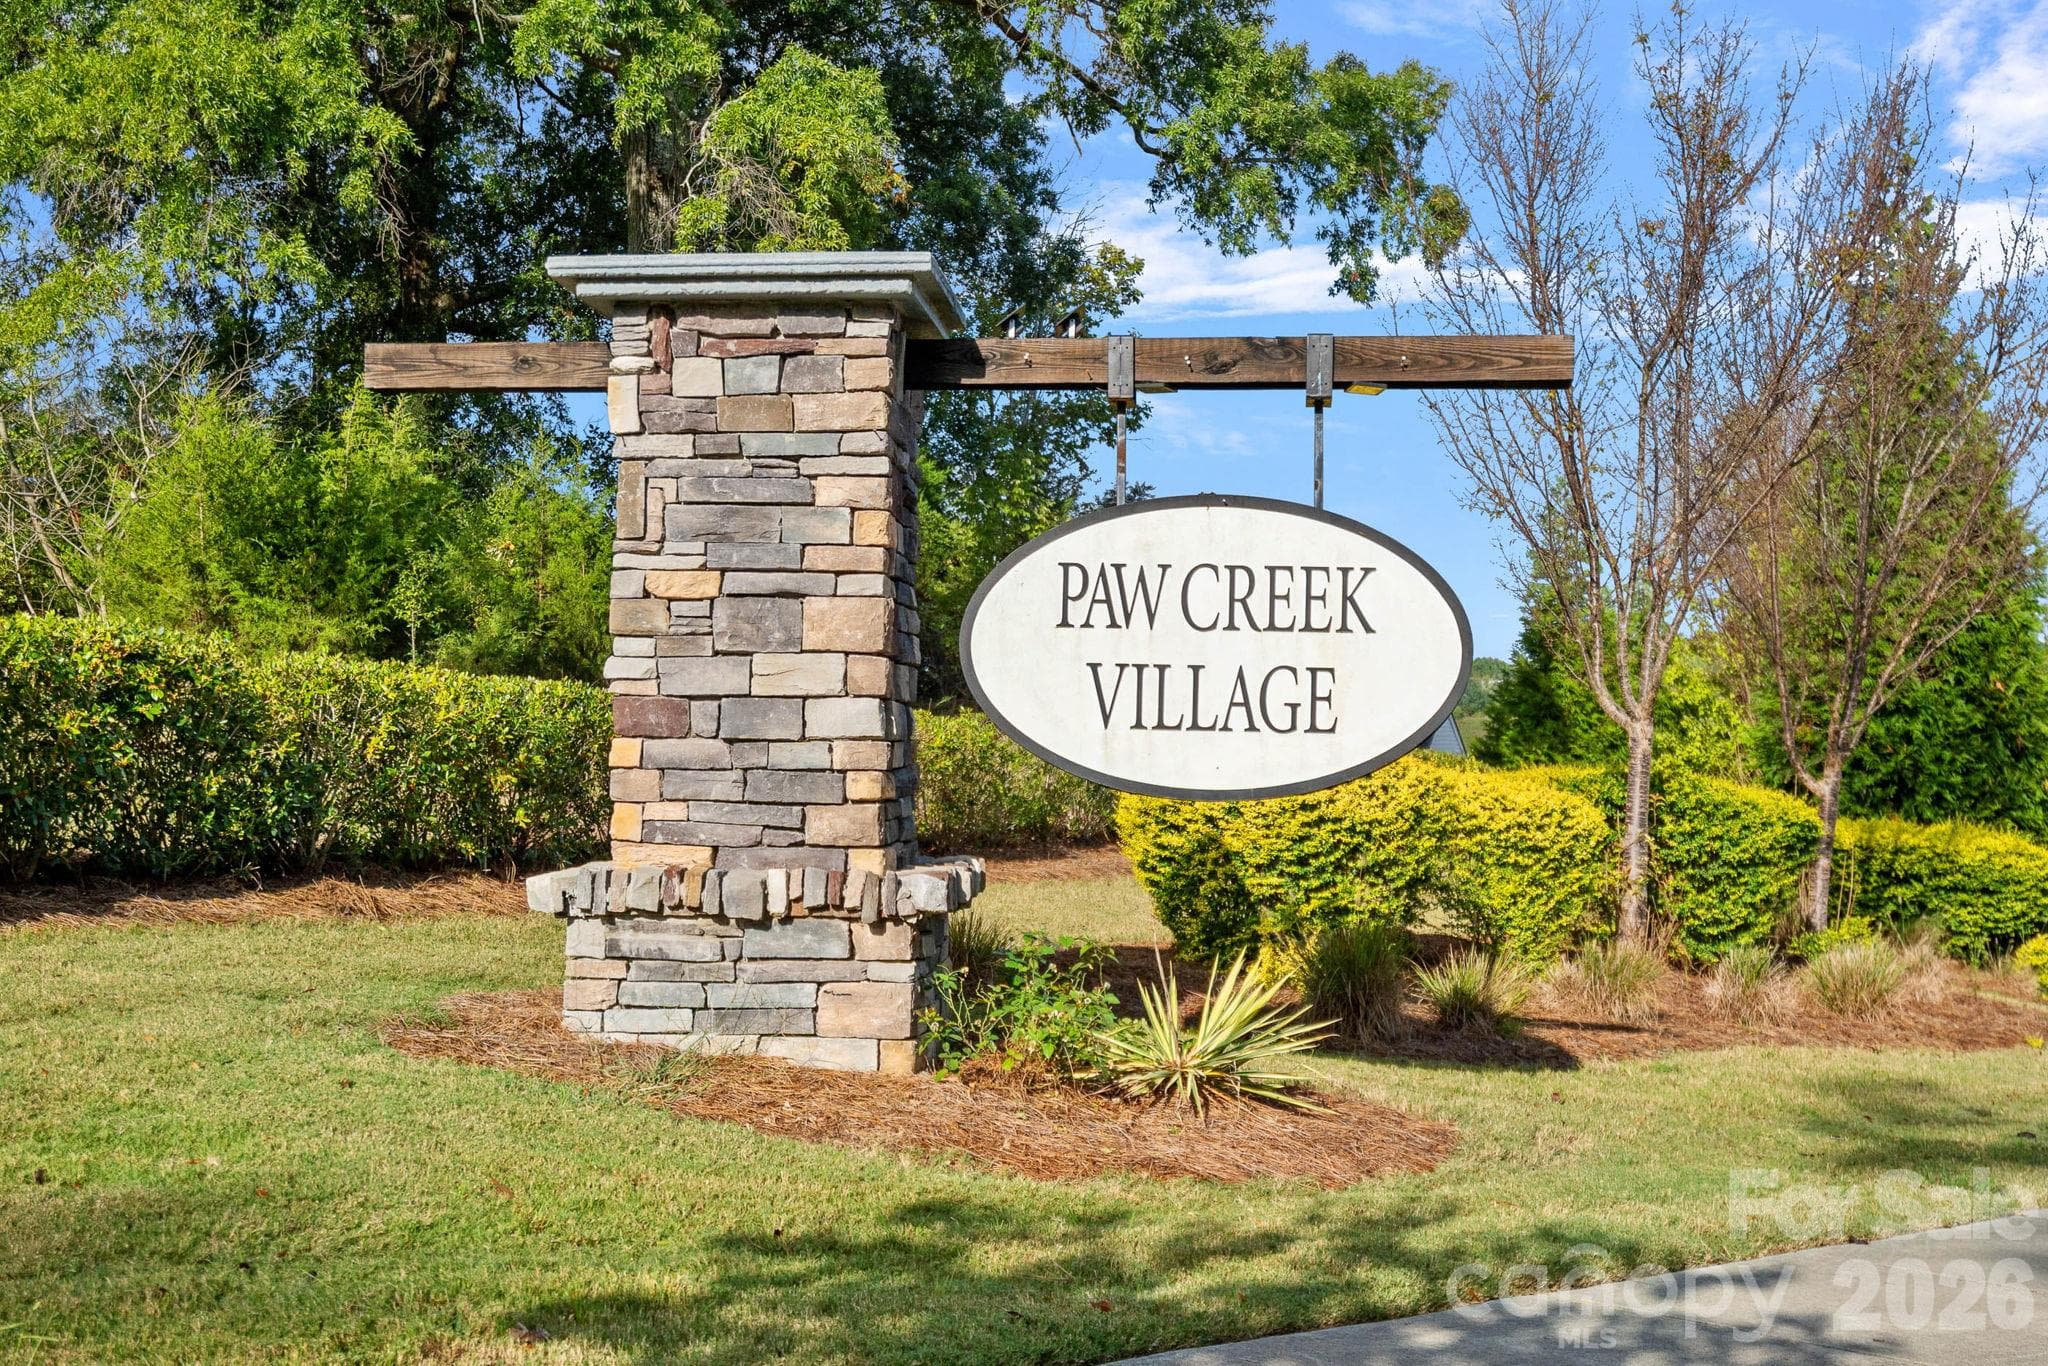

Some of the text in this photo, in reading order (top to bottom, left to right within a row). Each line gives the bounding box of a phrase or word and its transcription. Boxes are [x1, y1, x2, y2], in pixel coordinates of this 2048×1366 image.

[1056, 562, 1377, 634] PAW CREEK
[1086, 663, 1338, 733] VILLAGE
